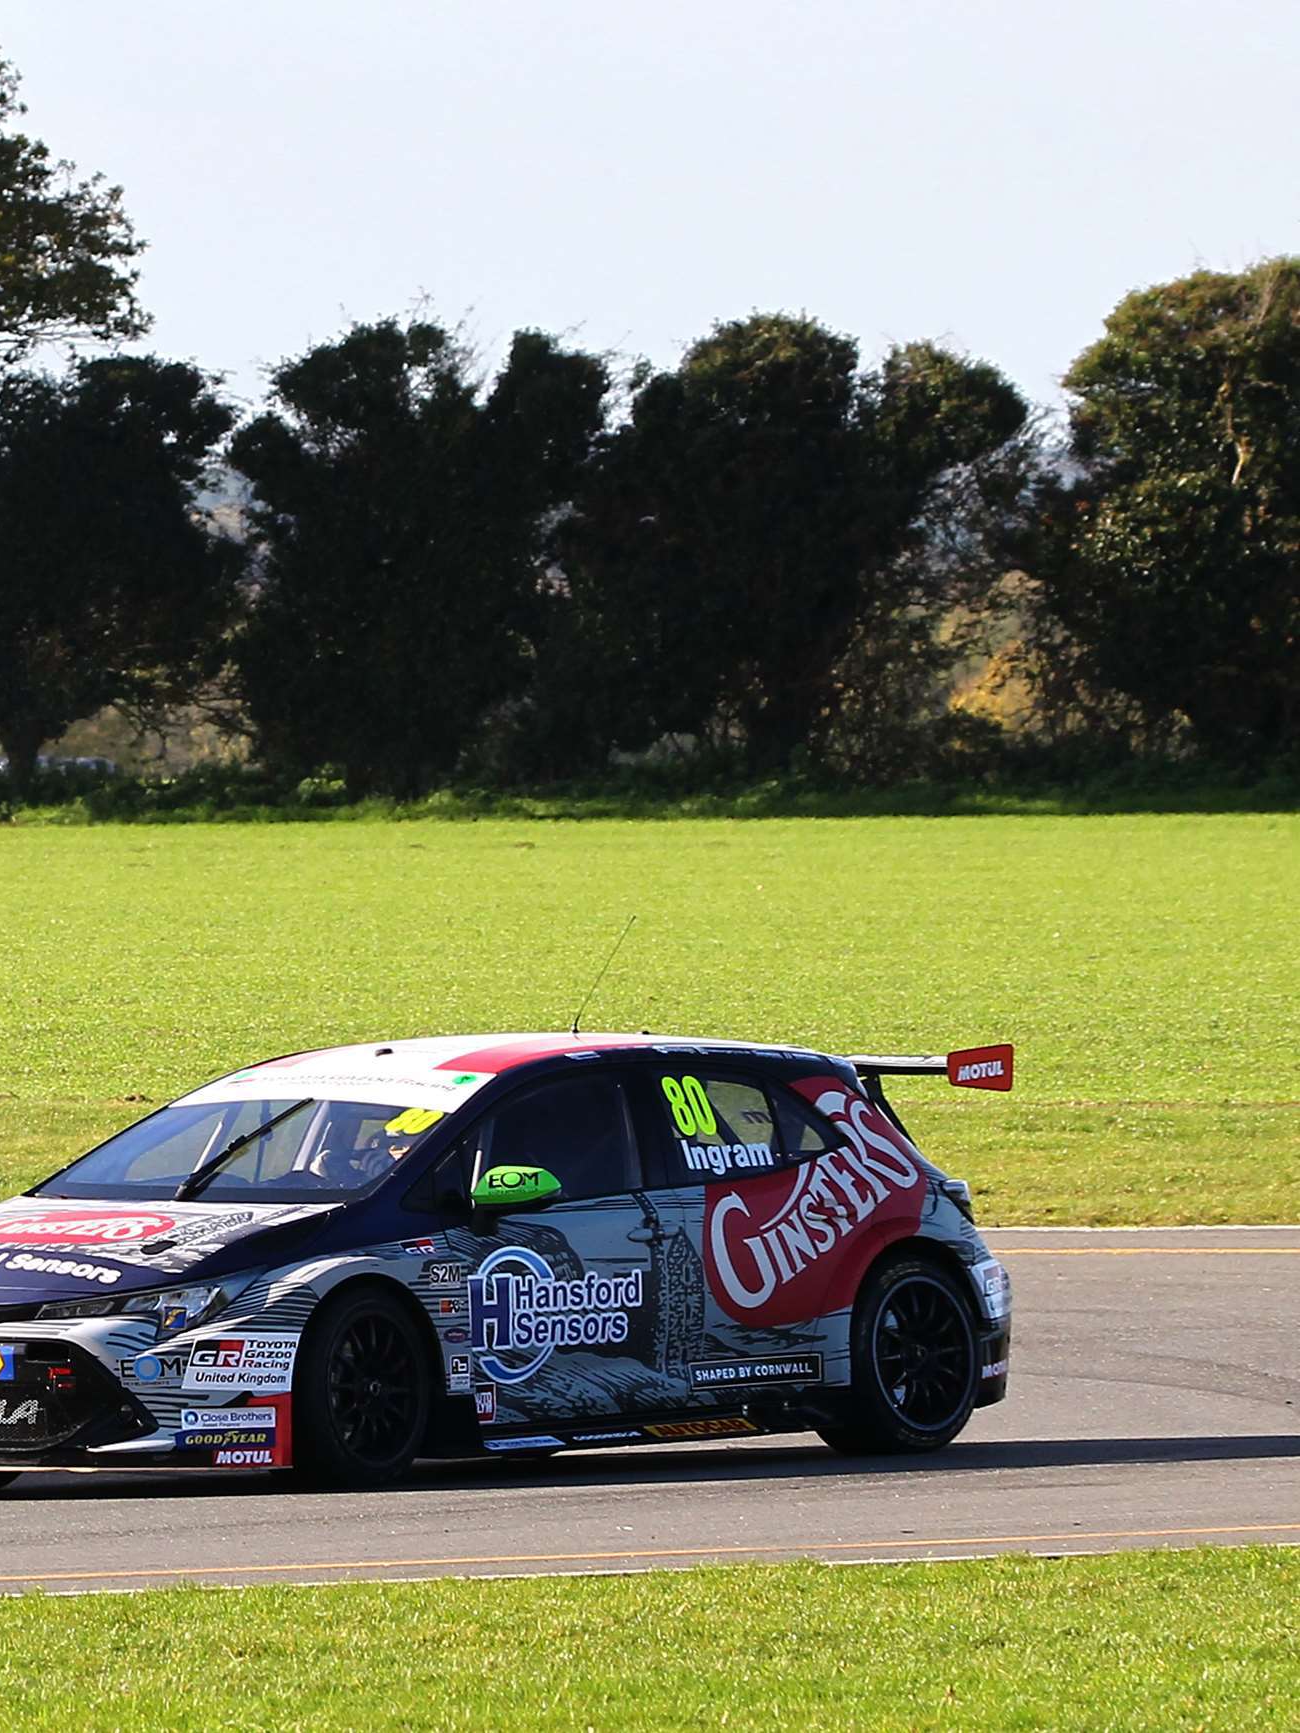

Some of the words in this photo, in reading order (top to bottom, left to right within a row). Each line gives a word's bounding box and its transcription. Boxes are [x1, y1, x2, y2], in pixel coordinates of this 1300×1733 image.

[957, 1060, 1004, 1081] MOTUL
[661, 1075, 717, 1136] 80
[384, 1108, 444, 1134] 80
[680, 1139, 775, 1176] Ingram
[489, 1171, 539, 1189] EOM
[5, 1253, 122, 1285] Sensors
[431, 1265, 460, 1282] S2M
[514, 1269, 642, 1311] Hansford
[514, 1312, 628, 1346] Sensors
[248, 1340, 297, 1349] TOYOTA
[192, 1350, 240, 1366] GR
[245, 1350, 292, 1359] GAZOO
[242, 1359, 290, 1371] Racing
[195, 1371, 236, 1383] United
[238, 1371, 287, 1386] Kingdom
[695, 1367, 736, 1381] SHAPED
[739, 1365, 752, 1378] BY
[754, 1362, 813, 1377] CORNWALL
[201, 1413, 229, 1422] Close
[230, 1411, 273, 1421] Brothers
[216, 1450, 273, 1464] MOTUL
